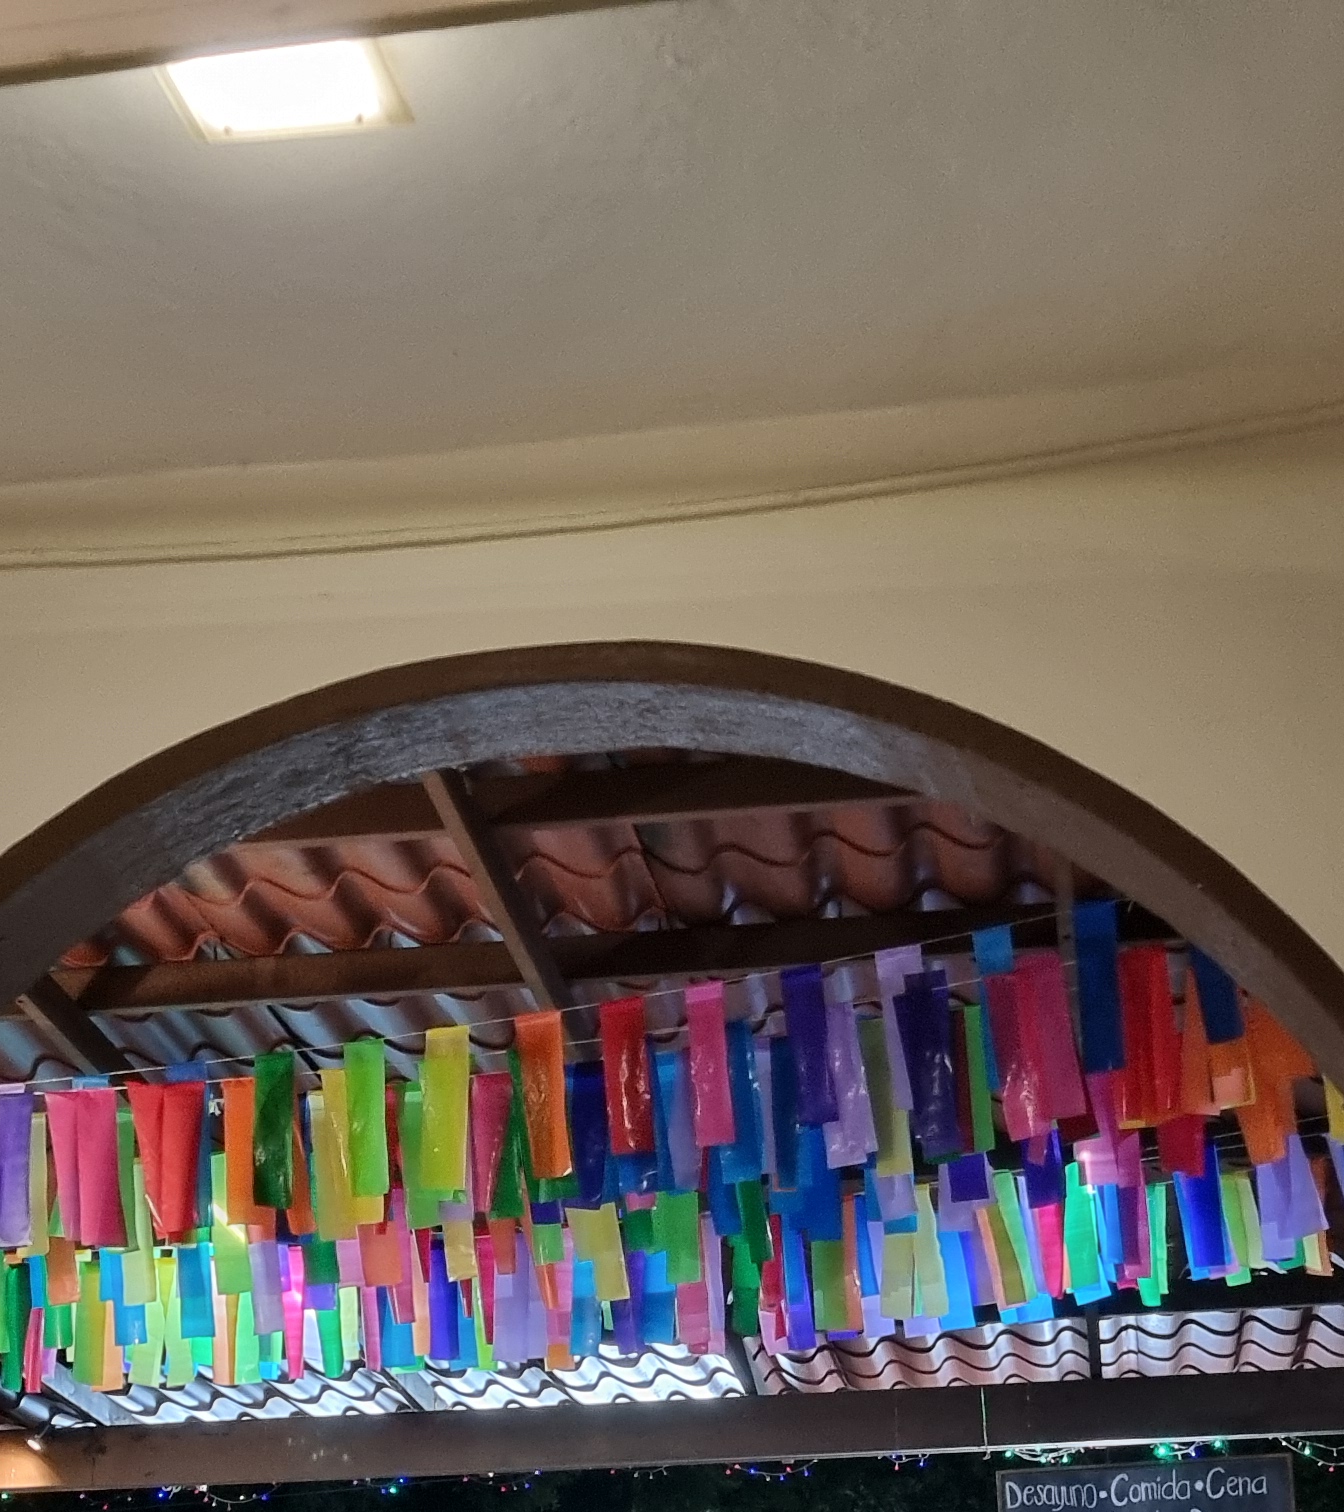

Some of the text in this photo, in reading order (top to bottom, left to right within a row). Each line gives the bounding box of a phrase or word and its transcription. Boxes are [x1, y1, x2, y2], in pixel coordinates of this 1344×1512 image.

[1006, 1467, 1268, 1511] Desayuno Comida Cena
